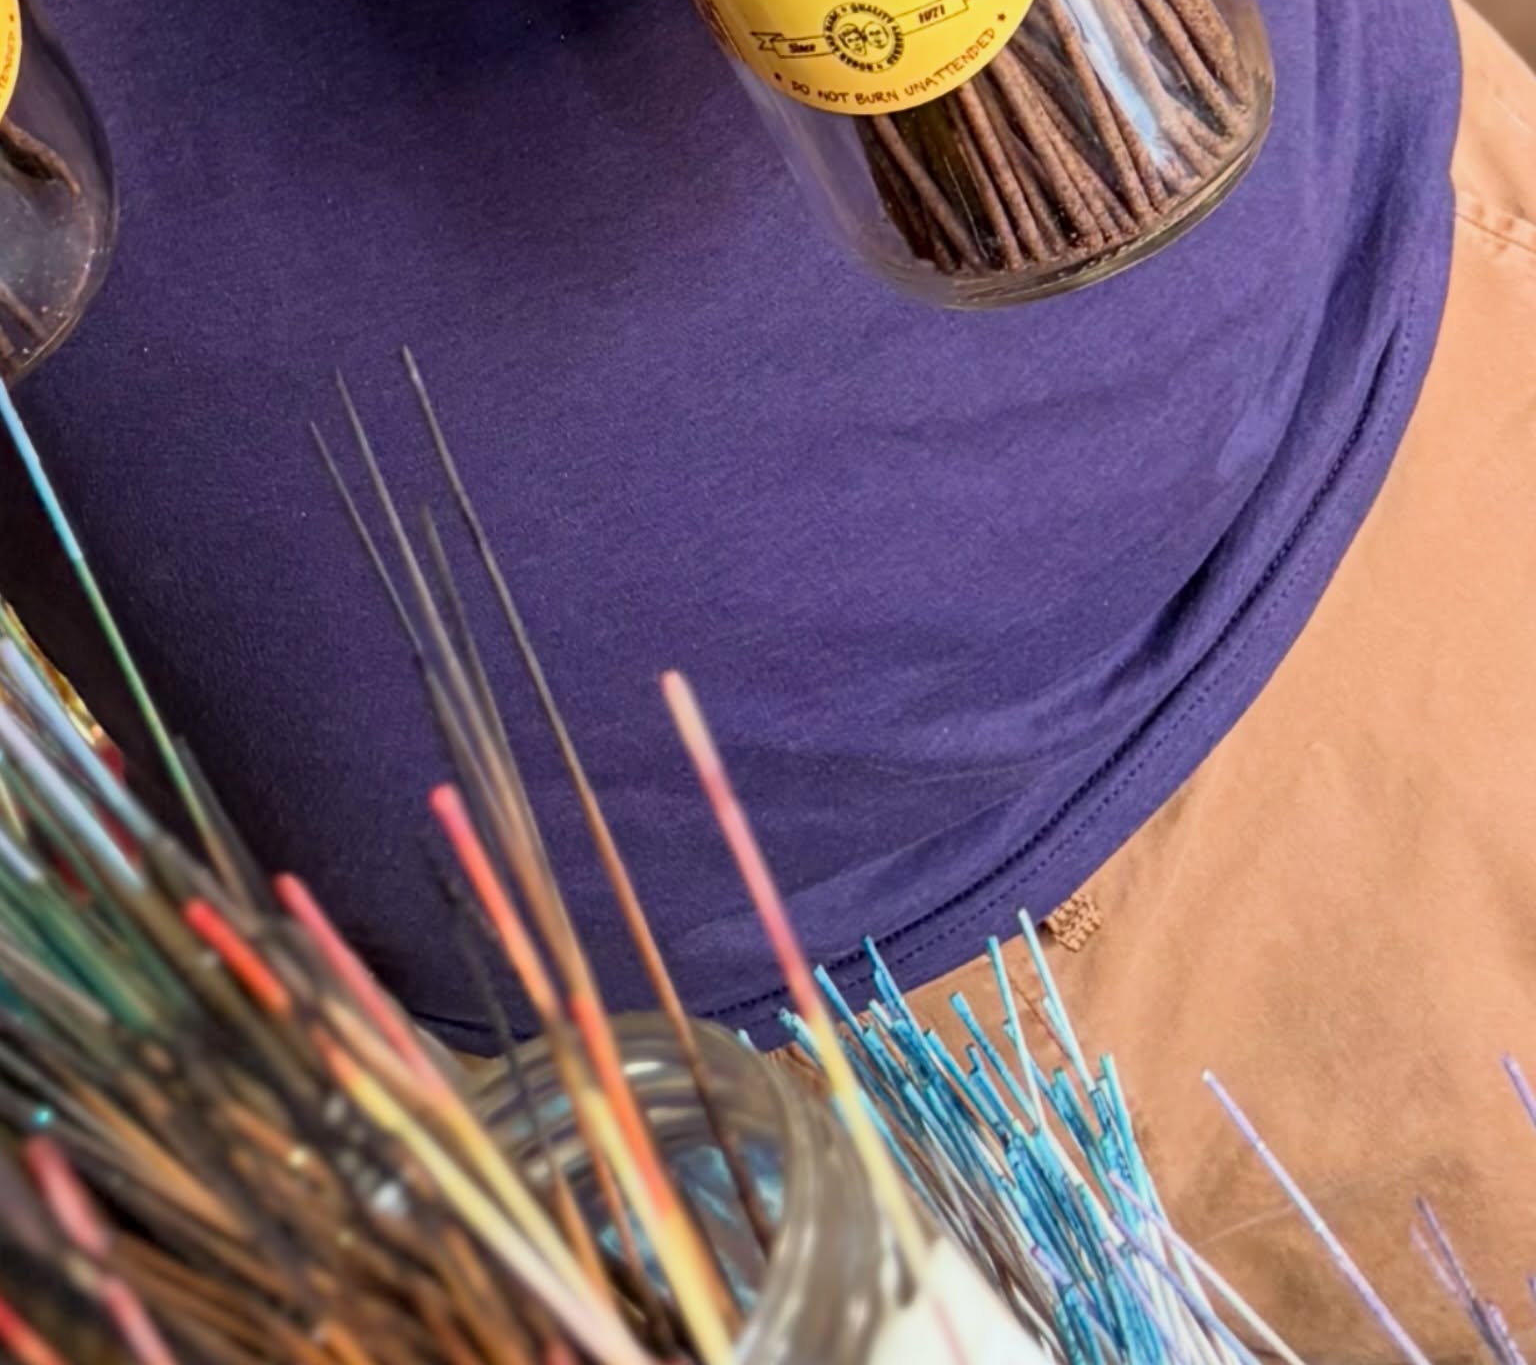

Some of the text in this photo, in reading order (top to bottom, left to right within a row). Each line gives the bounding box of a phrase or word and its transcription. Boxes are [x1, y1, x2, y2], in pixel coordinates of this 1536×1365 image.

[791, 27, 995, 106] DO NOT BURN UNATTENDED
